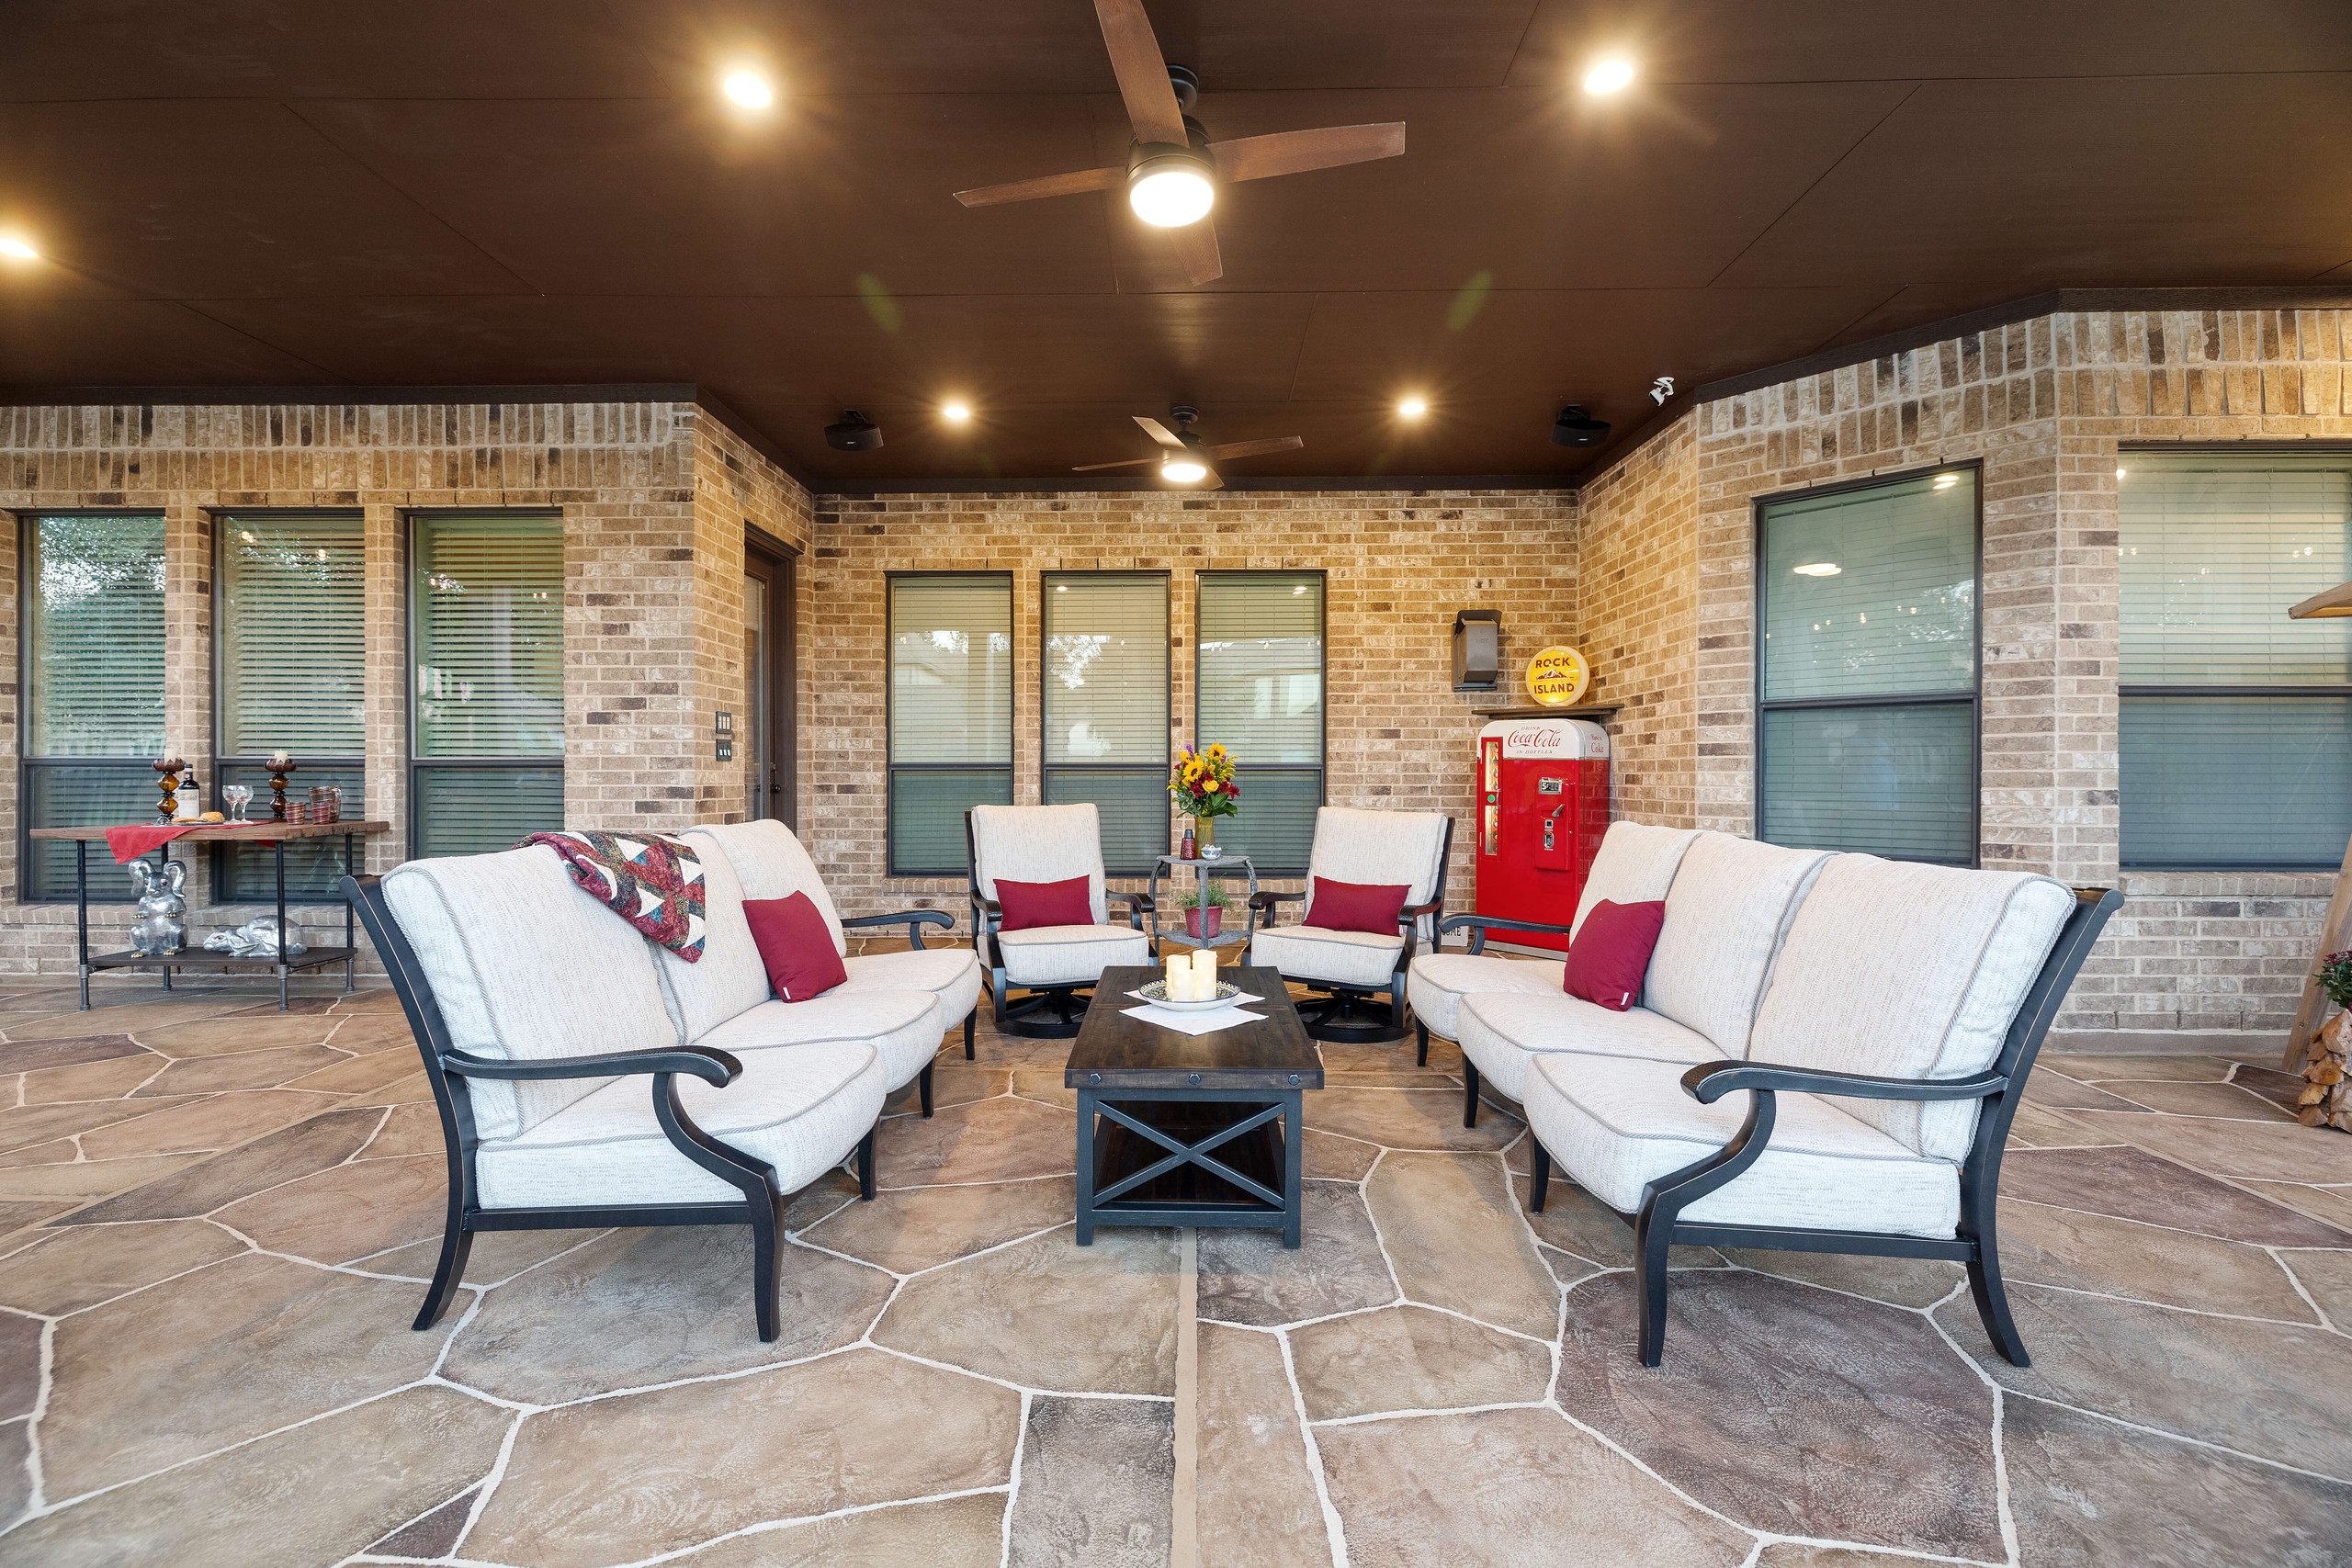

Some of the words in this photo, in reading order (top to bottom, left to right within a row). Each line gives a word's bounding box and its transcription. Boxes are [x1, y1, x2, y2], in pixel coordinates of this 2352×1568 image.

[1535, 658, 1570, 668] ROCK
[1534, 683, 1575, 694] ISLAND
[1508, 728, 1563, 748] Coca-Cola
[1591, 742, 1604, 752] Coke
